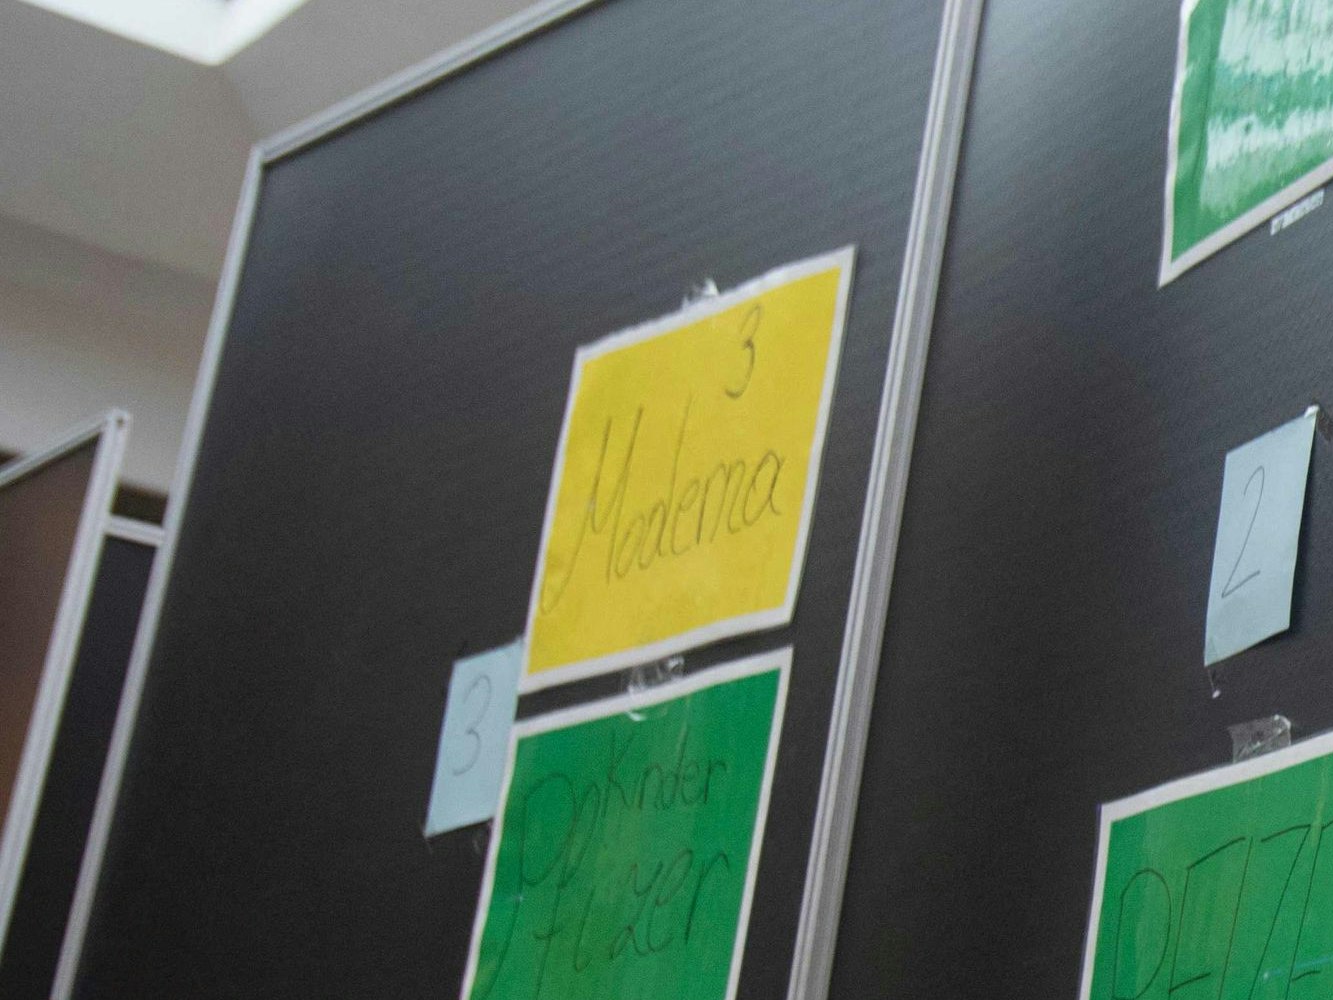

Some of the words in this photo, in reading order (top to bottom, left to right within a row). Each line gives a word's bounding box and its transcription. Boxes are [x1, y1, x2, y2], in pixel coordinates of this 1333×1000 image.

[723, 302, 764, 399] 3
[539, 390, 787, 616] Moderna
[1221, 464, 1266, 600] 2
[453, 674, 493, 777] 3
